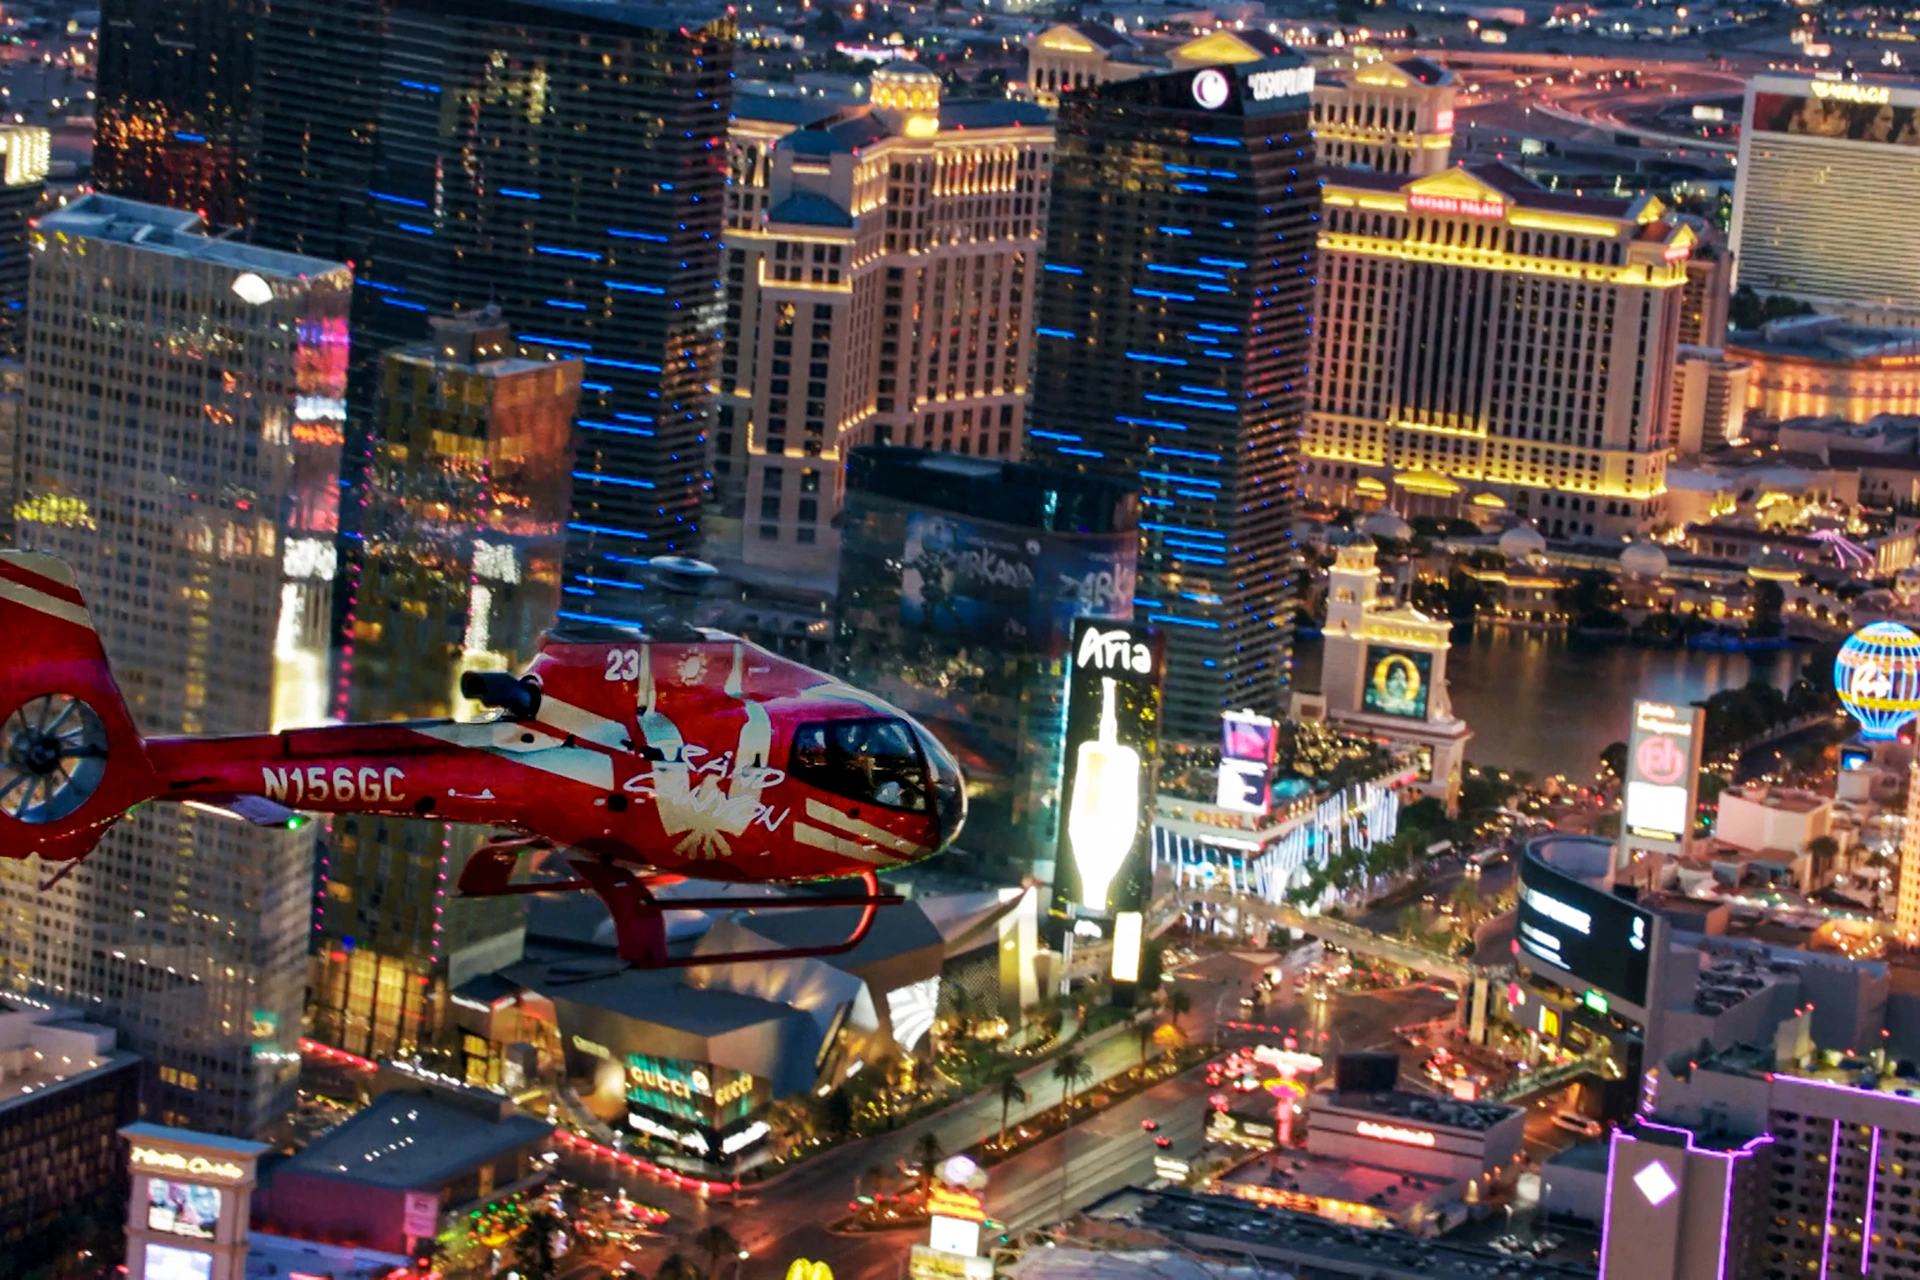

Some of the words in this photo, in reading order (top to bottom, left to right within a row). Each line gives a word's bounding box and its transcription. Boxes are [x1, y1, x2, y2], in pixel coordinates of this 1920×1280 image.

[1460, 200, 1504, 218] PALACE
[604, 649, 639, 681] 23
[1077, 627, 1152, 674] Aria
[262, 766, 405, 803] N156GC
[630, 1066, 692, 1099] GUCCI
[714, 1073, 754, 1107] GUCCI
